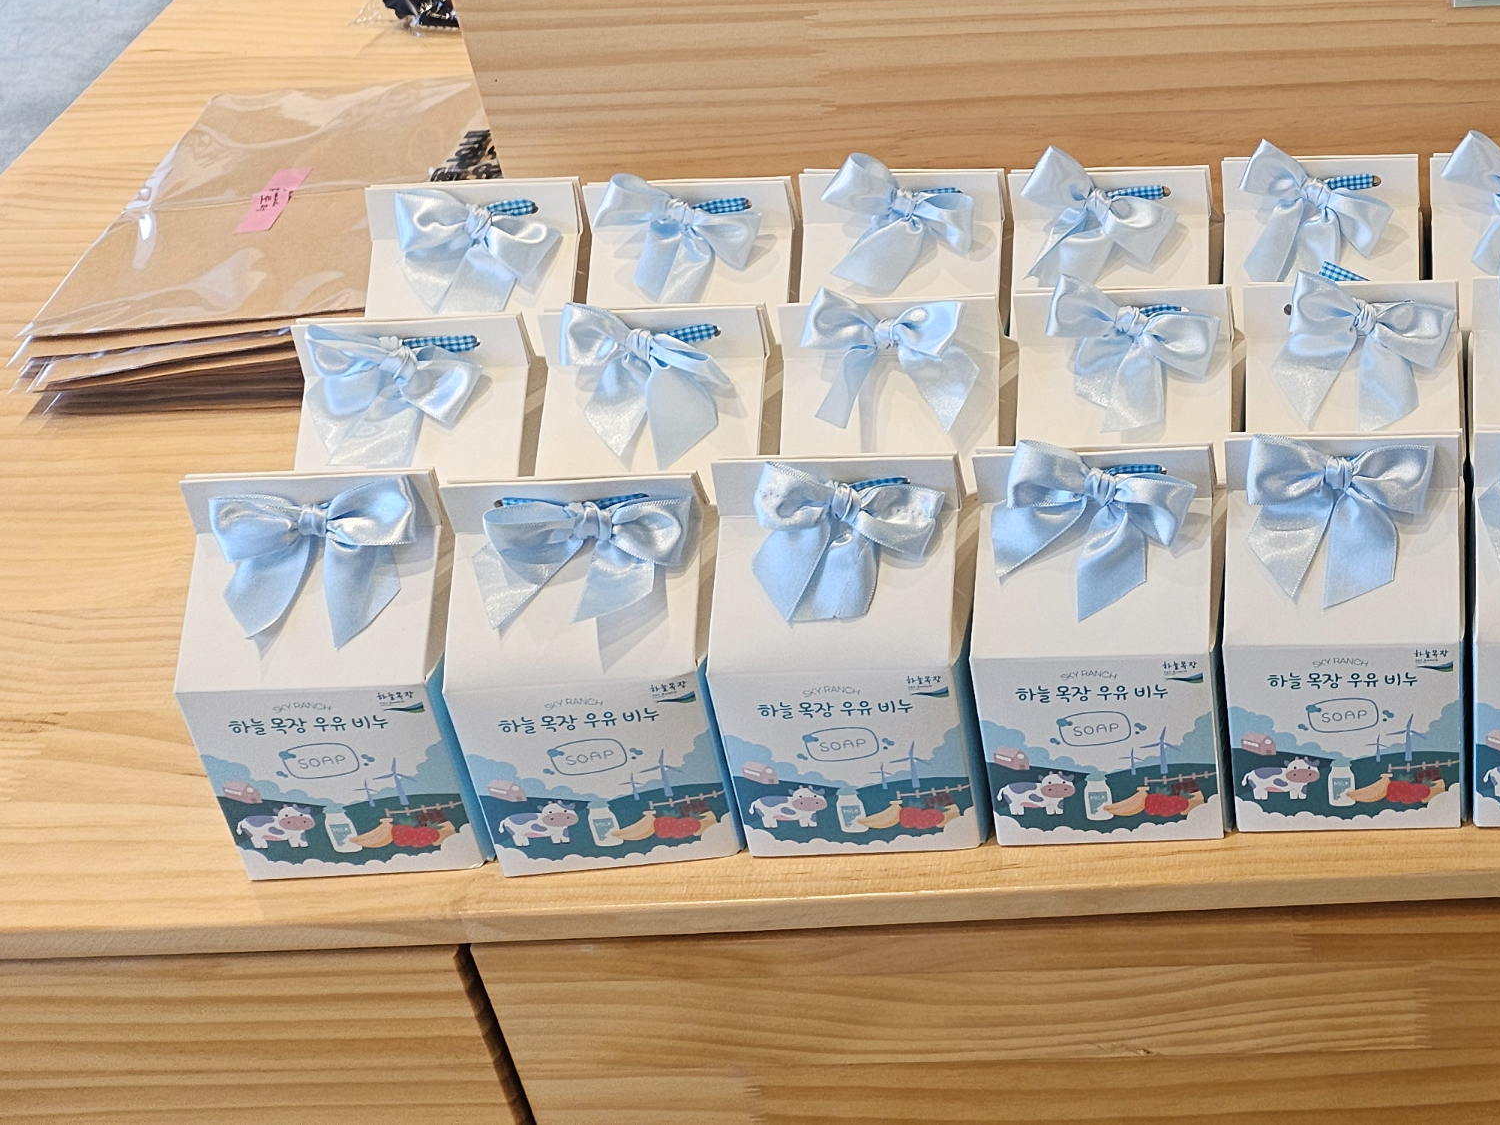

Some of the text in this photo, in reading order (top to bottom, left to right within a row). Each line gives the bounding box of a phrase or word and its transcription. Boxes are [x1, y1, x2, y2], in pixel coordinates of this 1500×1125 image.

[1267, 672, 1417, 689] 하늘 목장 우유 비누
[1016, 684, 1168, 703] 하늘 목장 우유 비누
[758, 699, 913, 719] 하늘 목장 우유 비누
[1320, 708, 1367, 723] SOAP
[229, 715, 388, 735] 하늘 목장 우유 비누
[498, 708, 659, 734] 하늘 목장 우유 비누
[1071, 722, 1119, 736] SOAP
[818, 739, 866, 752] SOAP
[298, 755, 345, 769] SOAP
[564, 750, 616, 768] SOAP
